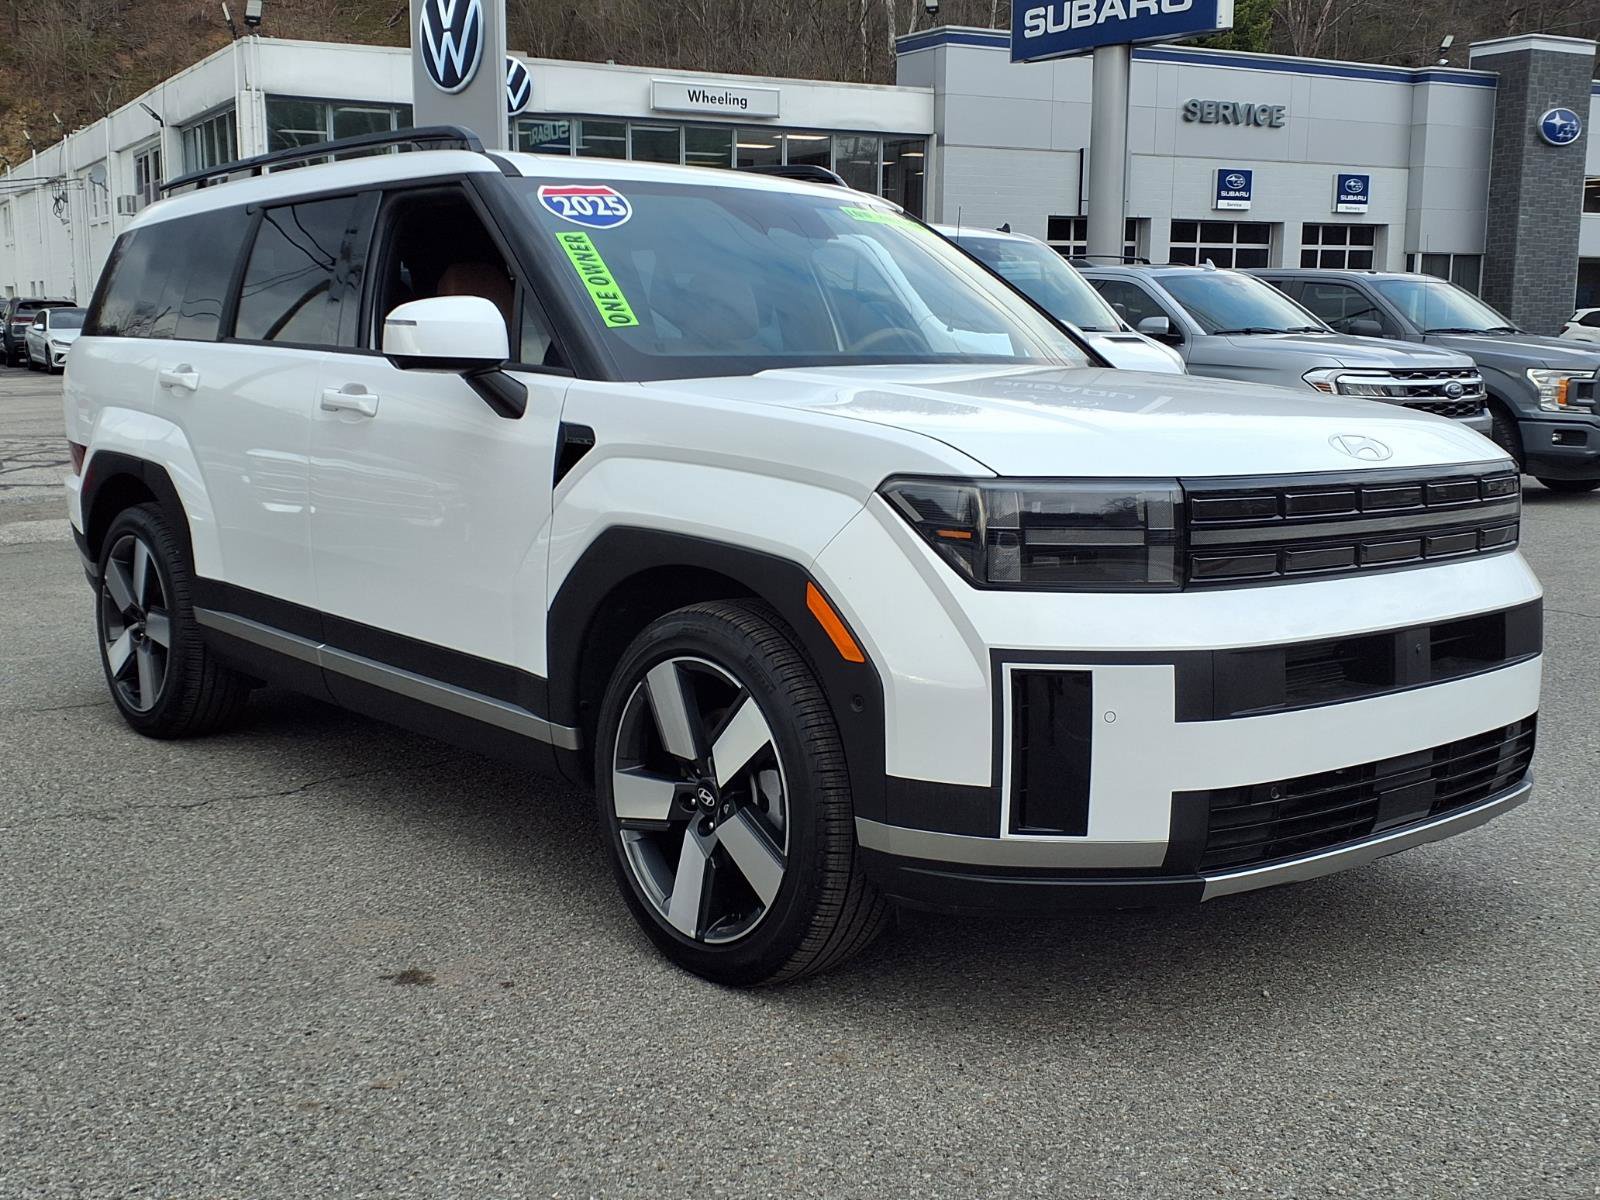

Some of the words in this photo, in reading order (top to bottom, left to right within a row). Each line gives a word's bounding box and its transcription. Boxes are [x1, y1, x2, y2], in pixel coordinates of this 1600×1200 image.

[688, 89, 748, 109] Wheeling
[1183, 99, 1286, 127] SERVICE
[552, 196, 627, 216] 2025
[563, 234, 610, 286] OWNER
[596, 290, 631, 324] ONE
